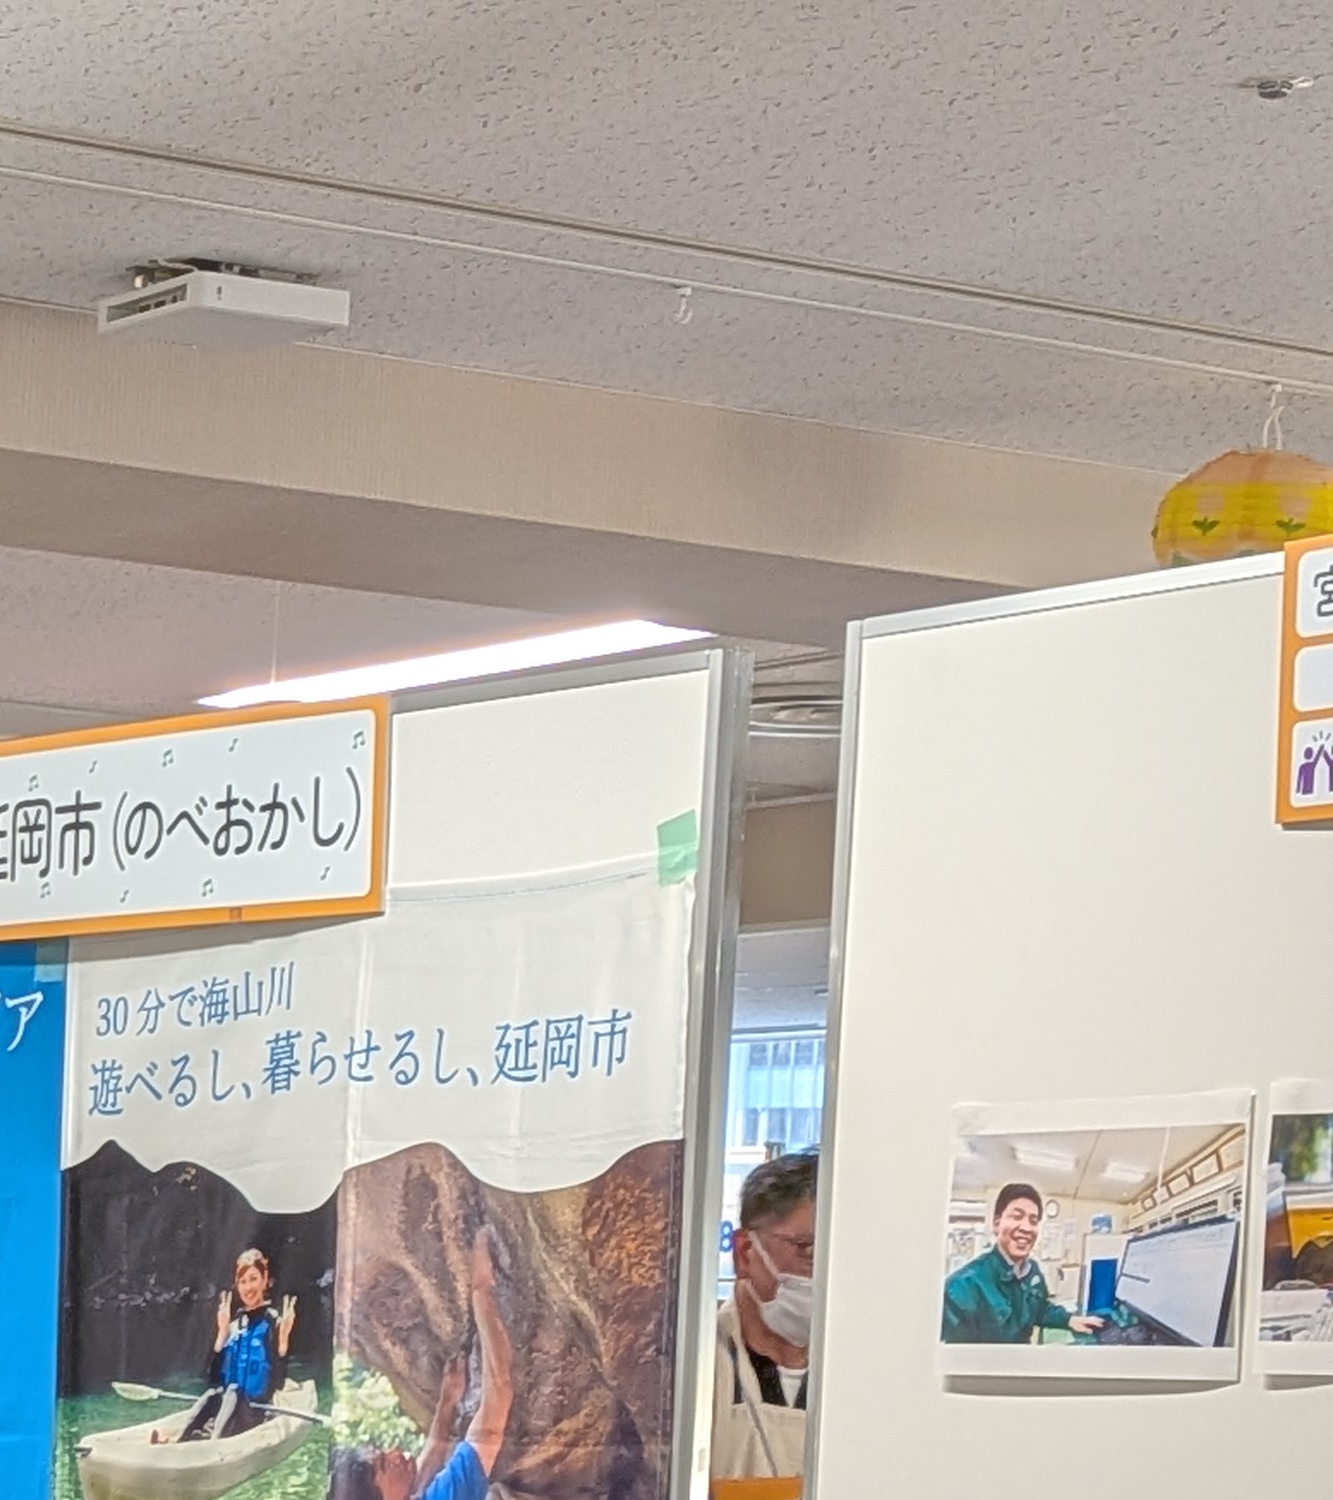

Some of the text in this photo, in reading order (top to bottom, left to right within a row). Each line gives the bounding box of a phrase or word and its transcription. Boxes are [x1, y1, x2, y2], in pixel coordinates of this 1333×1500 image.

[95, 961, 294, 1039] 30分で海山川
[87, 1008, 634, 1118] 遊べるし、暮らせるし、延岡市
